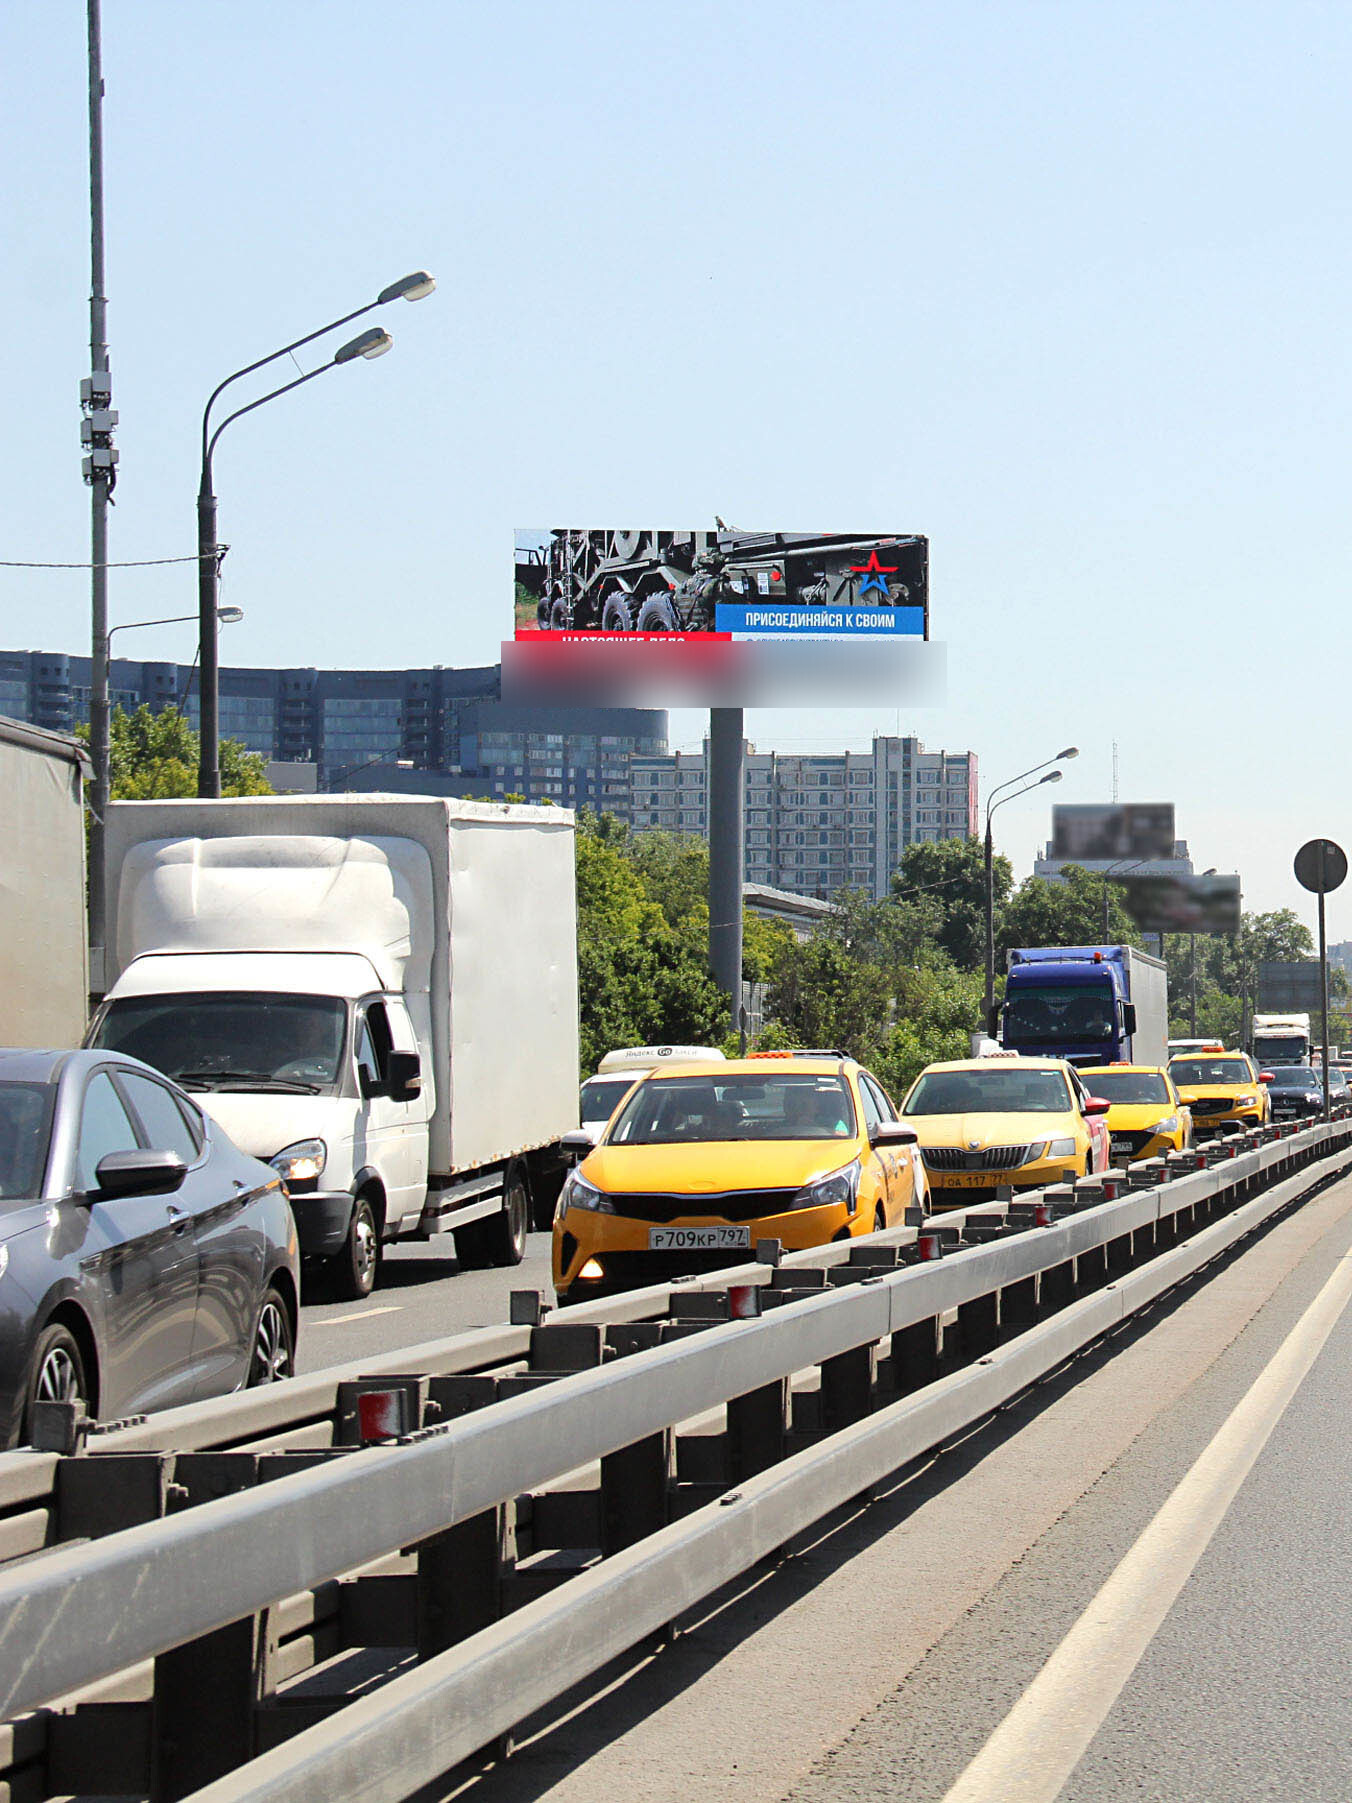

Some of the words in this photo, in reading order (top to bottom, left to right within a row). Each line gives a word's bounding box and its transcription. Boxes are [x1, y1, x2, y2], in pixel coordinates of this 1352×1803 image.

[745, 611, 843, 628] ПРИСОЕДИНЯЙСЯ
[845, 613, 853, 627] К
[855, 613, 895, 628] СВОИМ
[655, 1232, 716, 1247] Р709КР
[720, 1230, 744, 1241] 797
